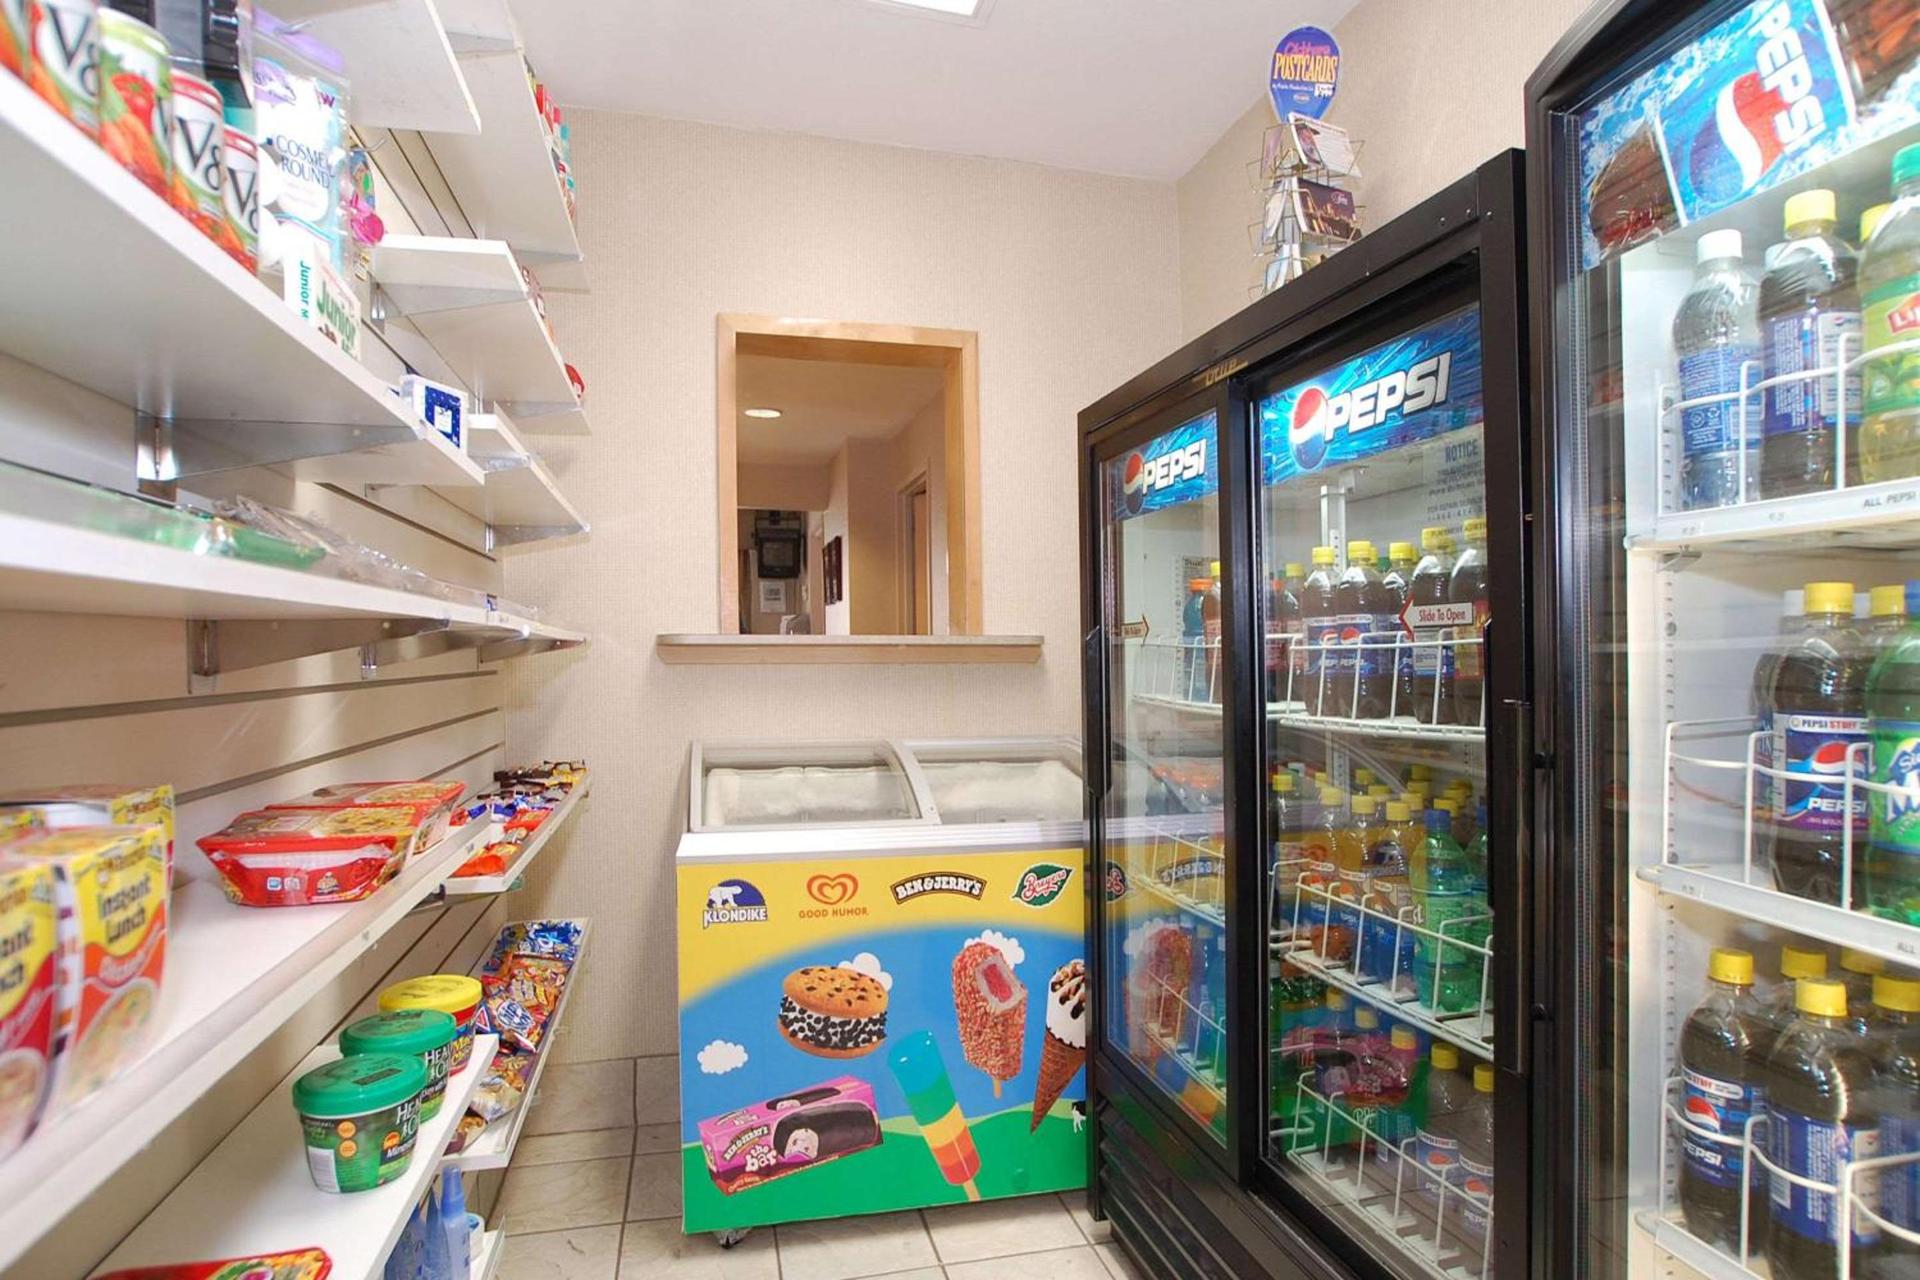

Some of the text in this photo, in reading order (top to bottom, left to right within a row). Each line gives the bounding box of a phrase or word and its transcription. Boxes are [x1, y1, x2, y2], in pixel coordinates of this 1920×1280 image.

[1273, 53, 1338, 82] POSTCARDS
[1747, 0, 1827, 153] PEPSI
[175, 114, 220, 191] V8
[300, 260, 311, 305] Junior
[316, 279, 356, 349] Junior
[1324, 352, 1452, 442] PEPSI
[1445, 440, 1479, 463] NOTICE
[1142, 438, 1207, 495] PEPSI
[1419, 607, 1466, 623] Slide To Open
[1801, 719, 1858, 730] PEPSI STUFF
[1807, 797, 1867, 813] PEPSI
[703, 907, 768, 930] KLONDIKE
[799, 906, 869, 919] GOOD HUMOR
[745, 1150, 777, 1172] bar
